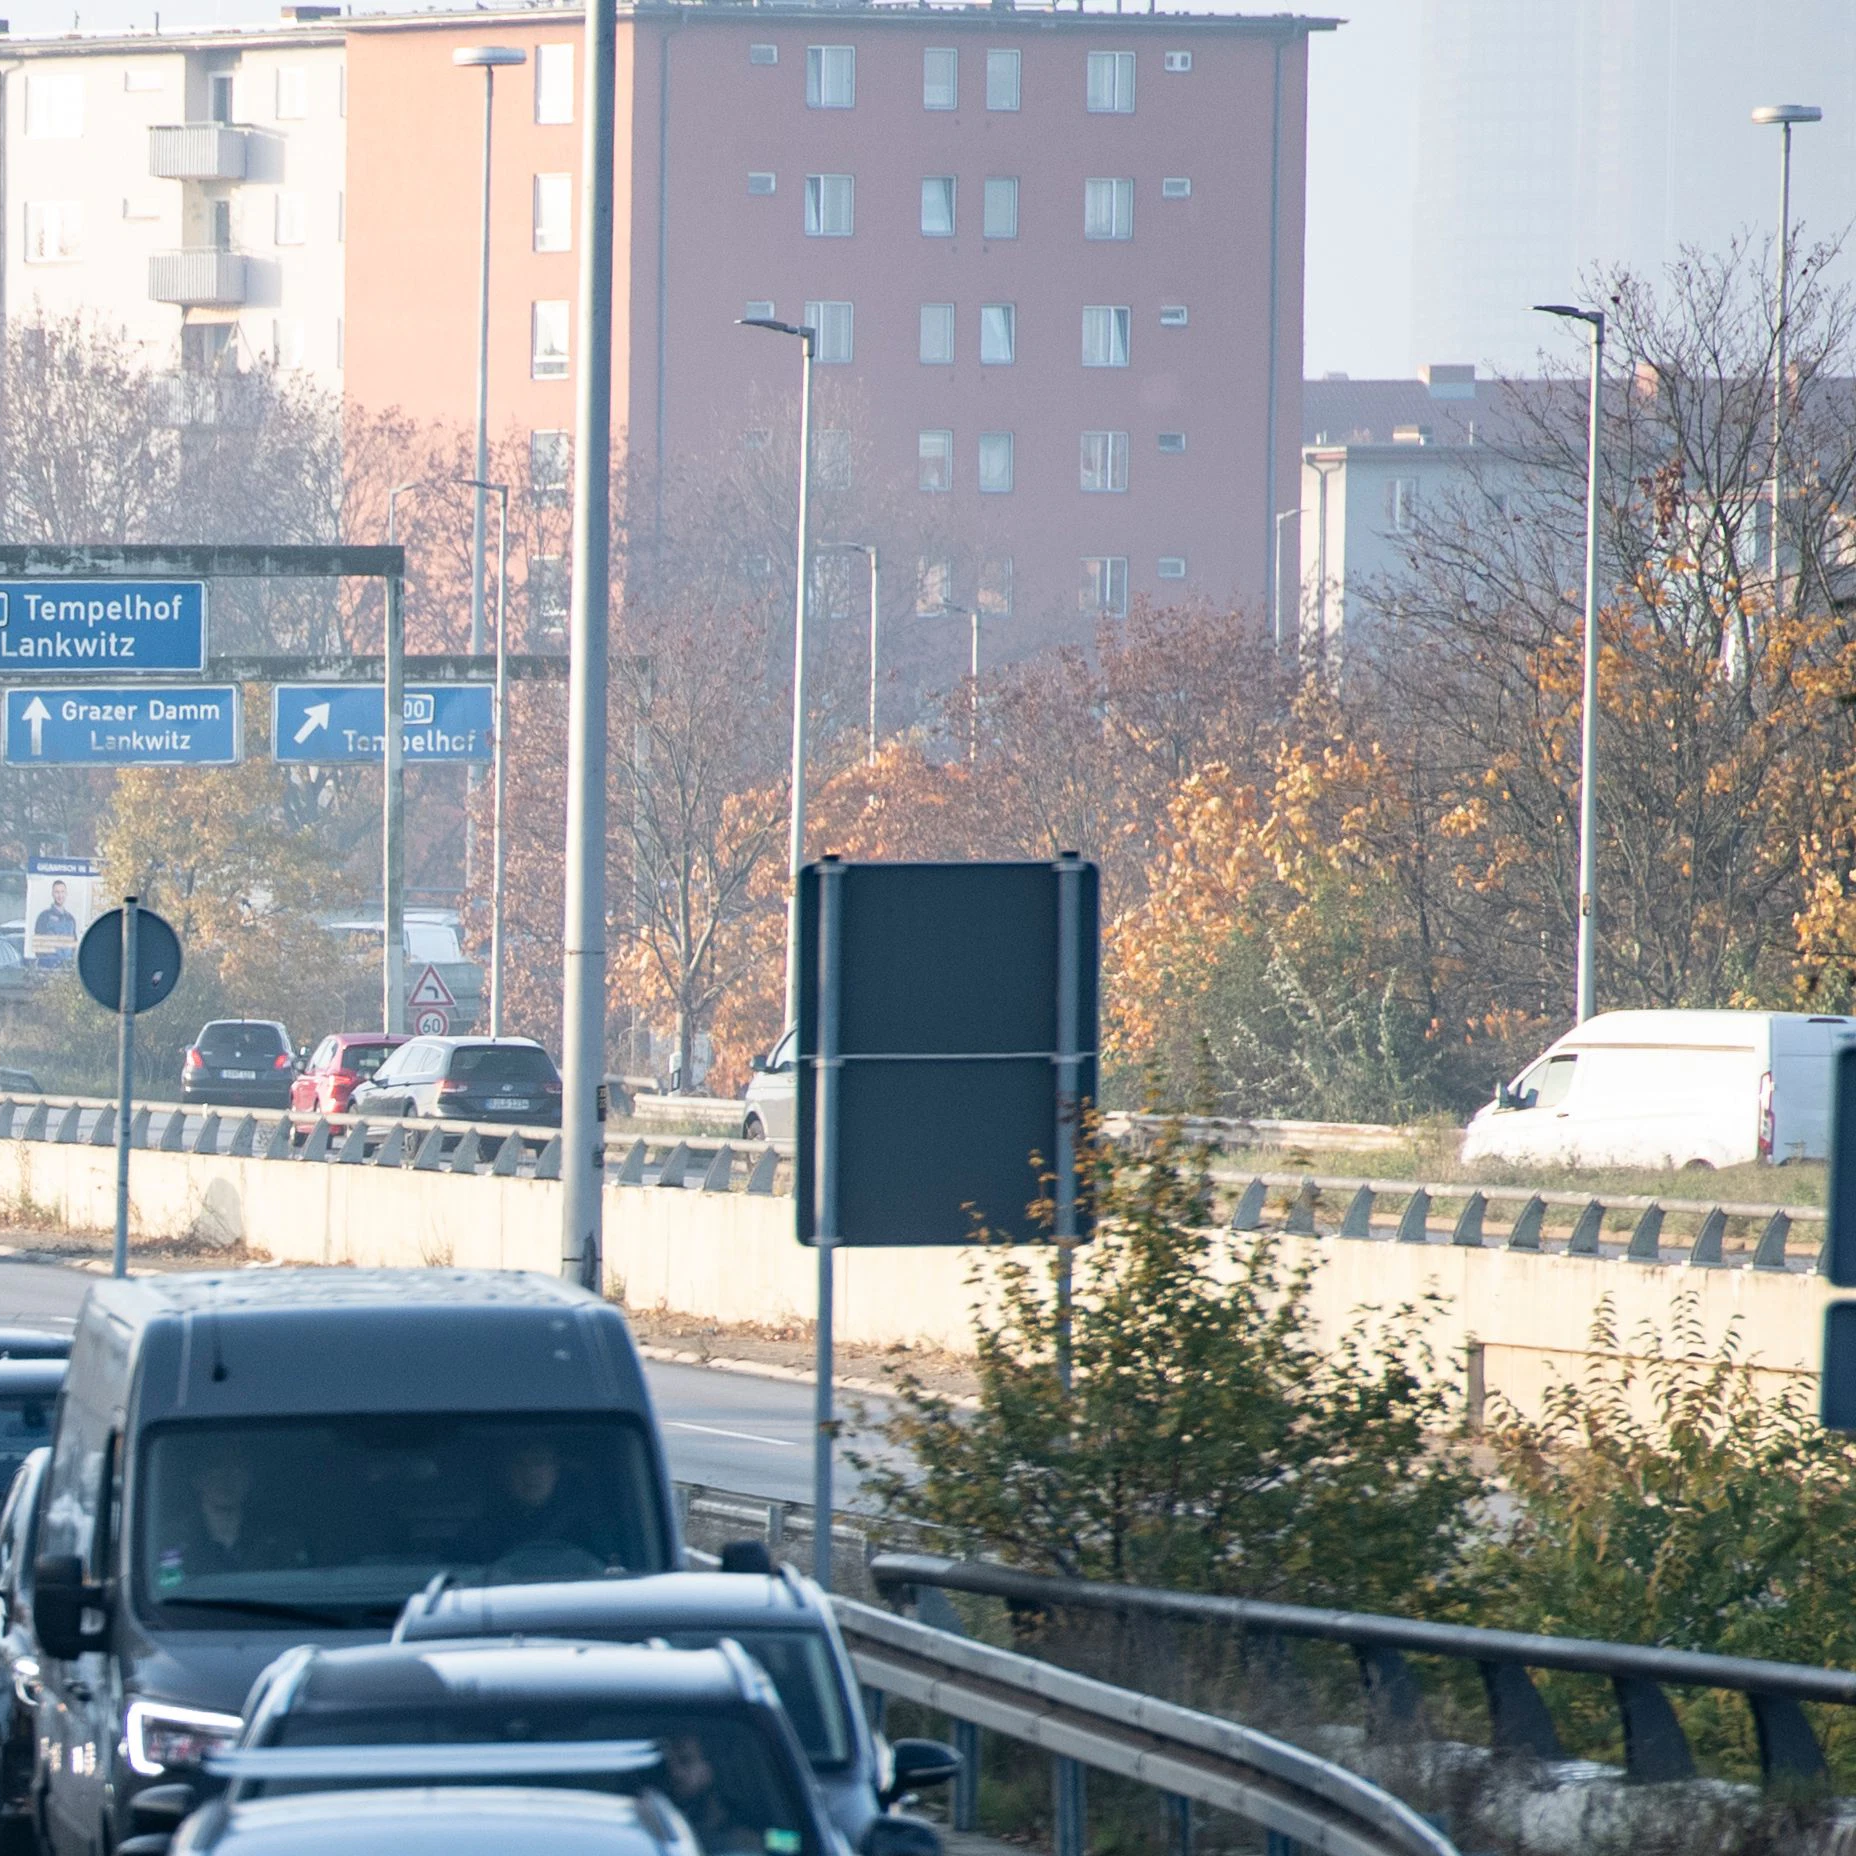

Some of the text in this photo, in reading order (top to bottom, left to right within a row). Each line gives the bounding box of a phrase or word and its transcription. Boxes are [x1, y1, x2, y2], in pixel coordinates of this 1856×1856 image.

[23, 594, 183, 628] Tempelhof
[1, 631, 135, 657] Lankwitz
[61, 700, 220, 721] Grazer Damm
[90, 730, 191, 751] Lankwitz
[422, 1017, 441, 1034] 60
